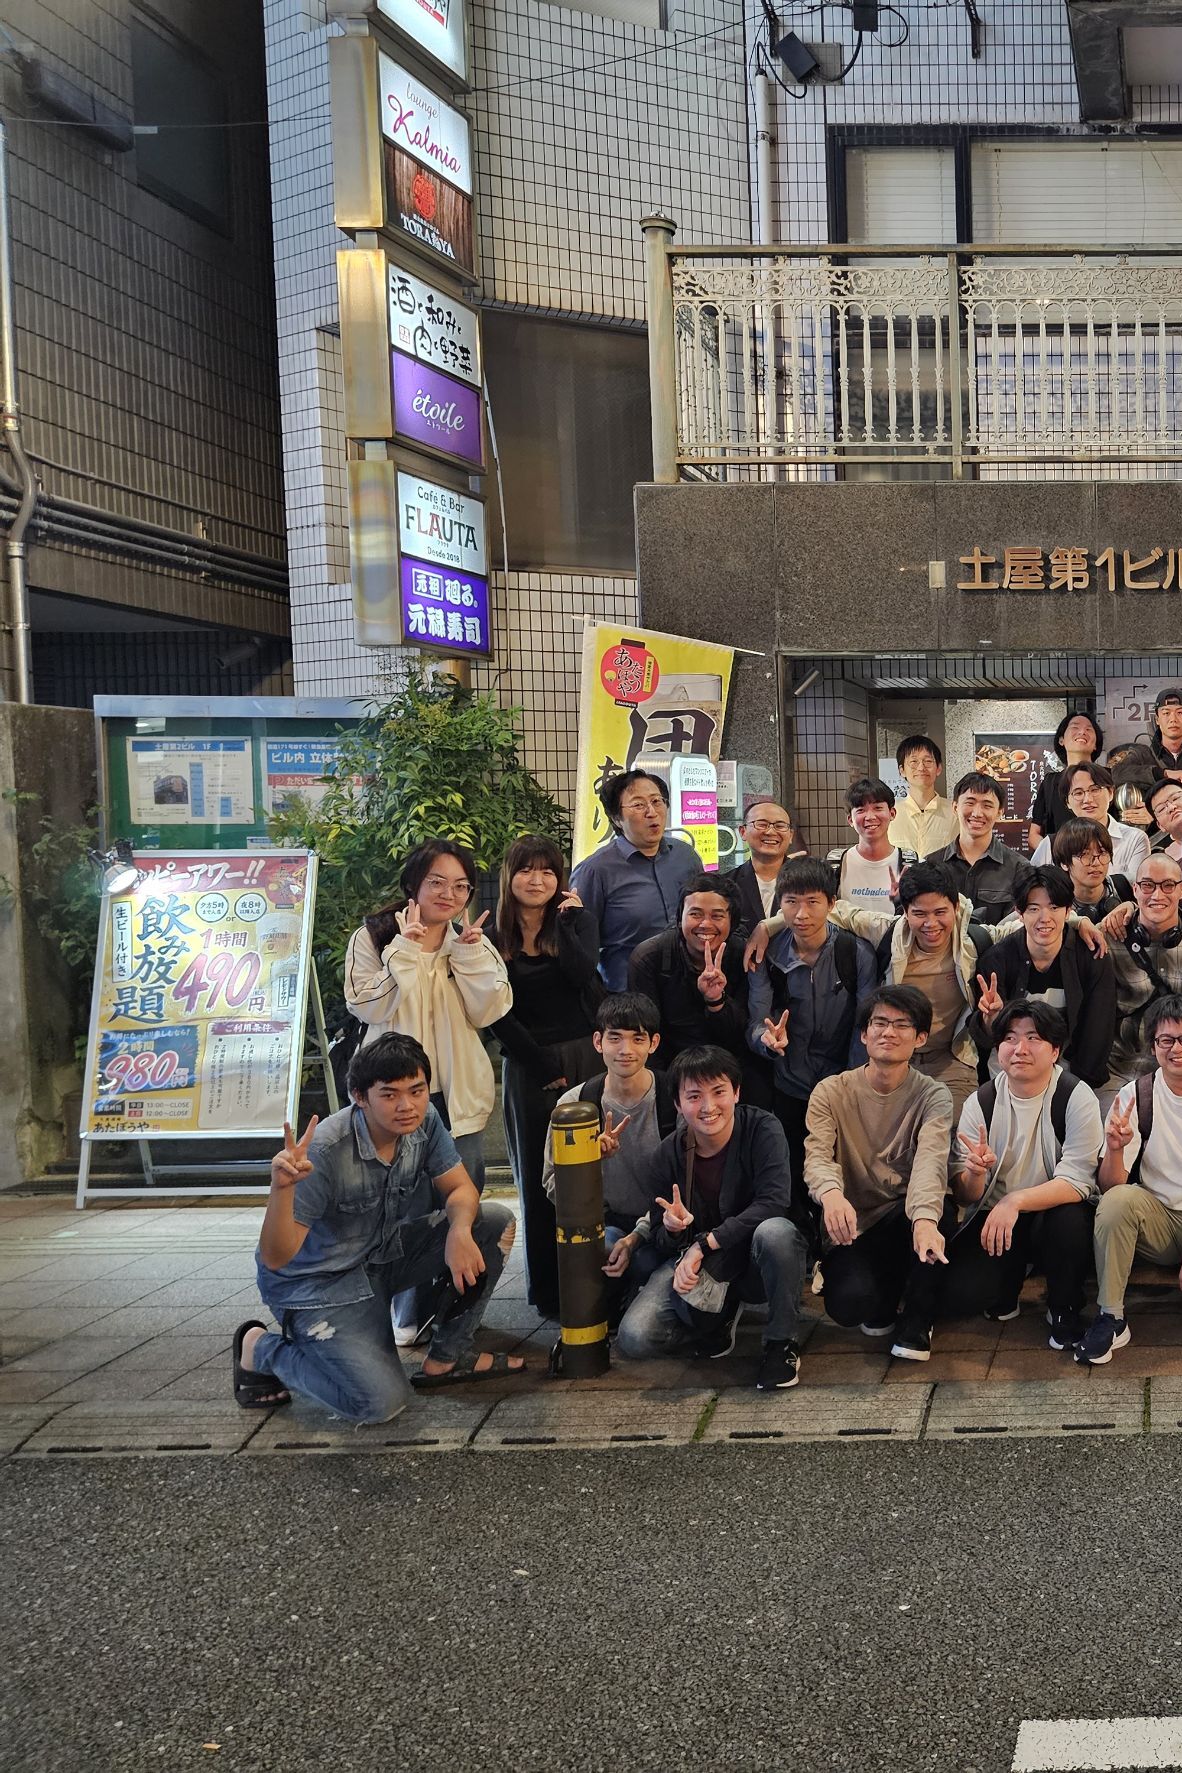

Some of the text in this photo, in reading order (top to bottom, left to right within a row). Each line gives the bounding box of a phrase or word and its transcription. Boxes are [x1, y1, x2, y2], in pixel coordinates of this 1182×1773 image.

[405, 82, 439, 119] lounge
[387, 94, 461, 173] Kalmia
[412, 388, 465, 431] étoile
[417, 486, 465, 514] Café & Bar
[405, 504, 479, 551] FLAUTA
[407, 602, 481, 646] 元禄寿司
[200, 900, 225, 910] 夕方5時
[225, 915, 237, 923] or
[240, 900, 261, 910] 夜8時
[107, 893, 197, 1025] 飲み放題
[115, 905, 130, 977] 生ビール付き
[200, 928, 249, 950] 1時間
[171, 951, 262, 1013] 490
[249, 996, 266, 1012] 円
[104, 1050, 179, 1095] 980
